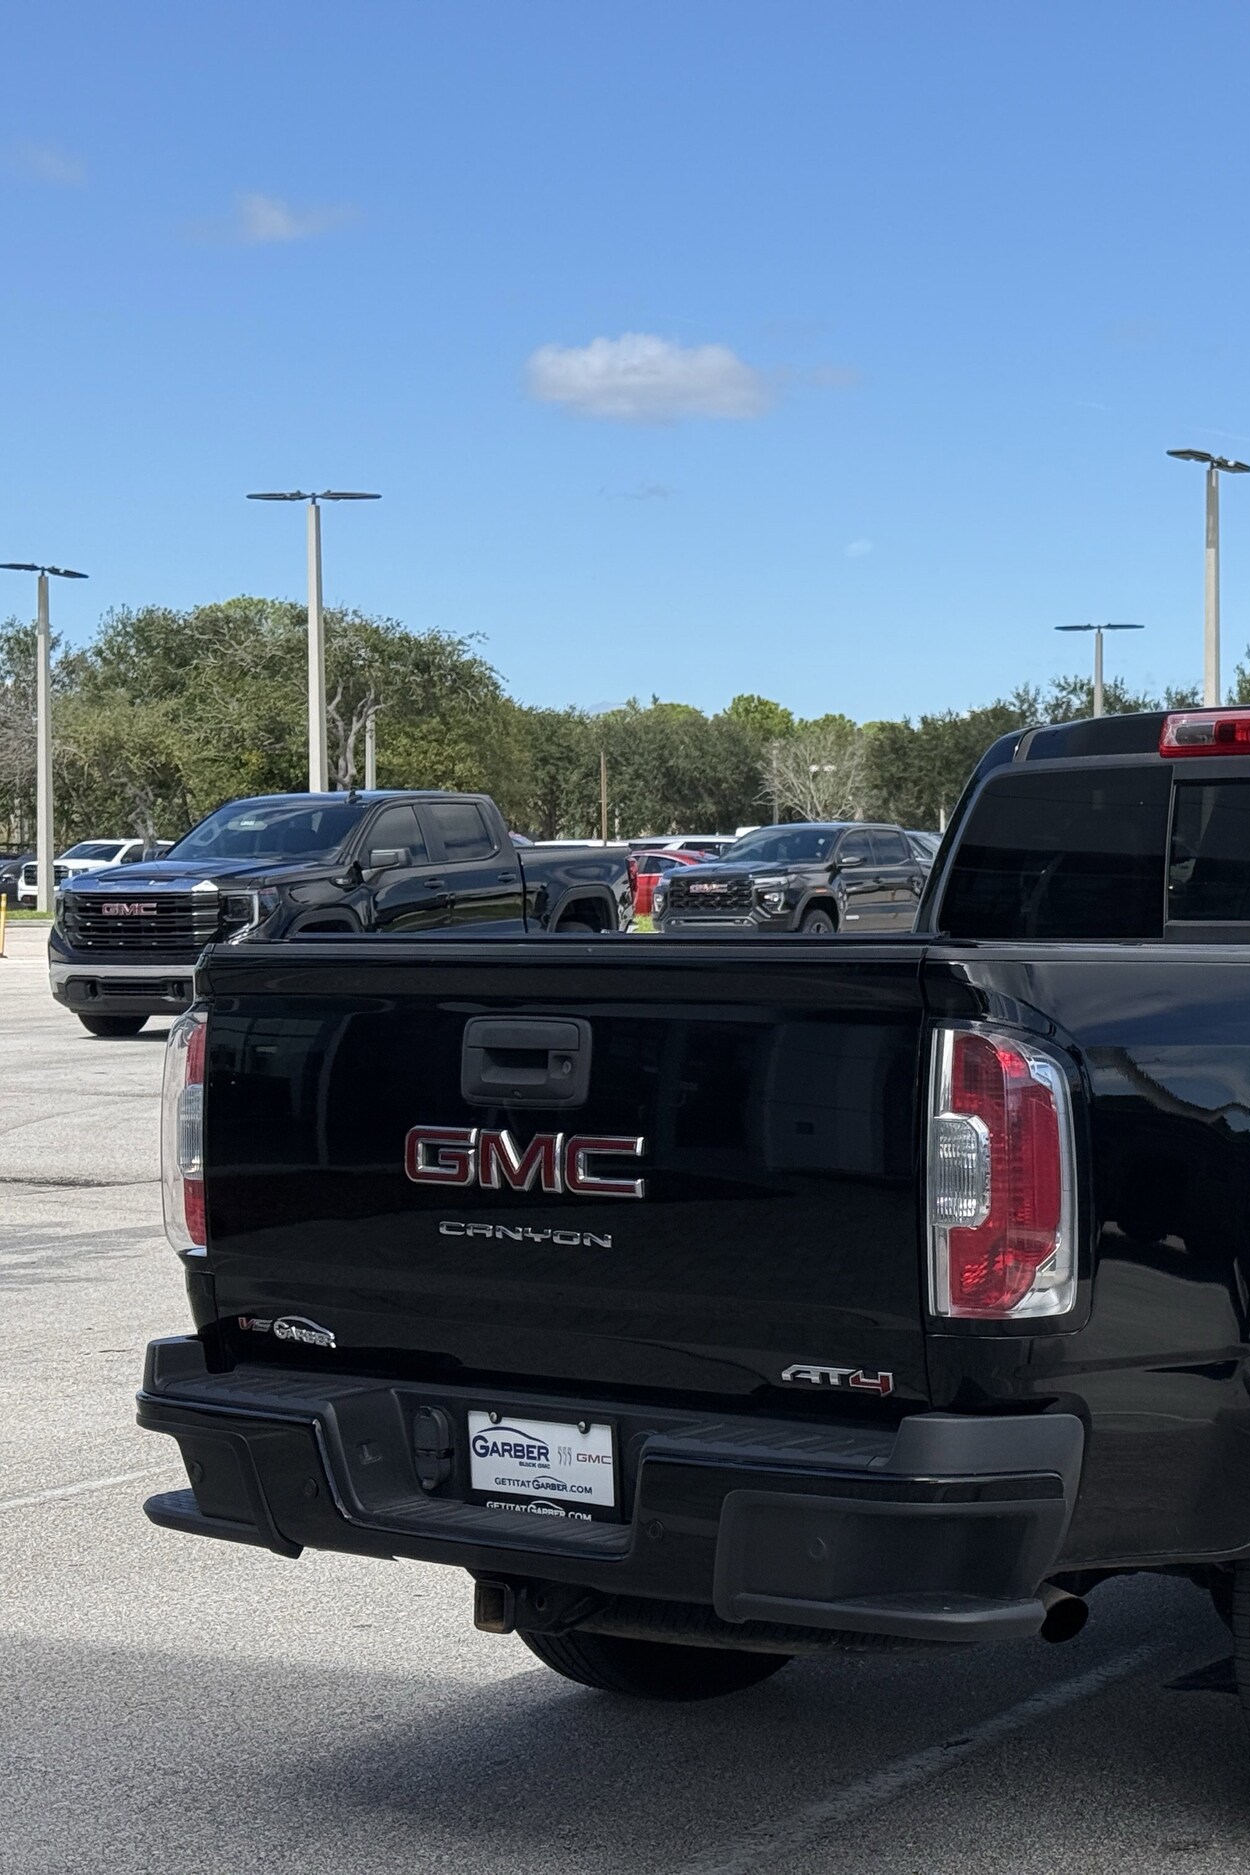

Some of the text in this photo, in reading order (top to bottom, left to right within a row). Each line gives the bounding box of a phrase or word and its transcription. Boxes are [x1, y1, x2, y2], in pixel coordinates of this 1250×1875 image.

[102, 903, 157, 915] GMC
[404, 1125, 645, 1198] GMC
[438, 1220, 612, 1248] CANYON
[781, 1364, 893, 1396] AT4
[472, 1435, 550, 1462] GARBER
[576, 1453, 612, 1465] GMC
